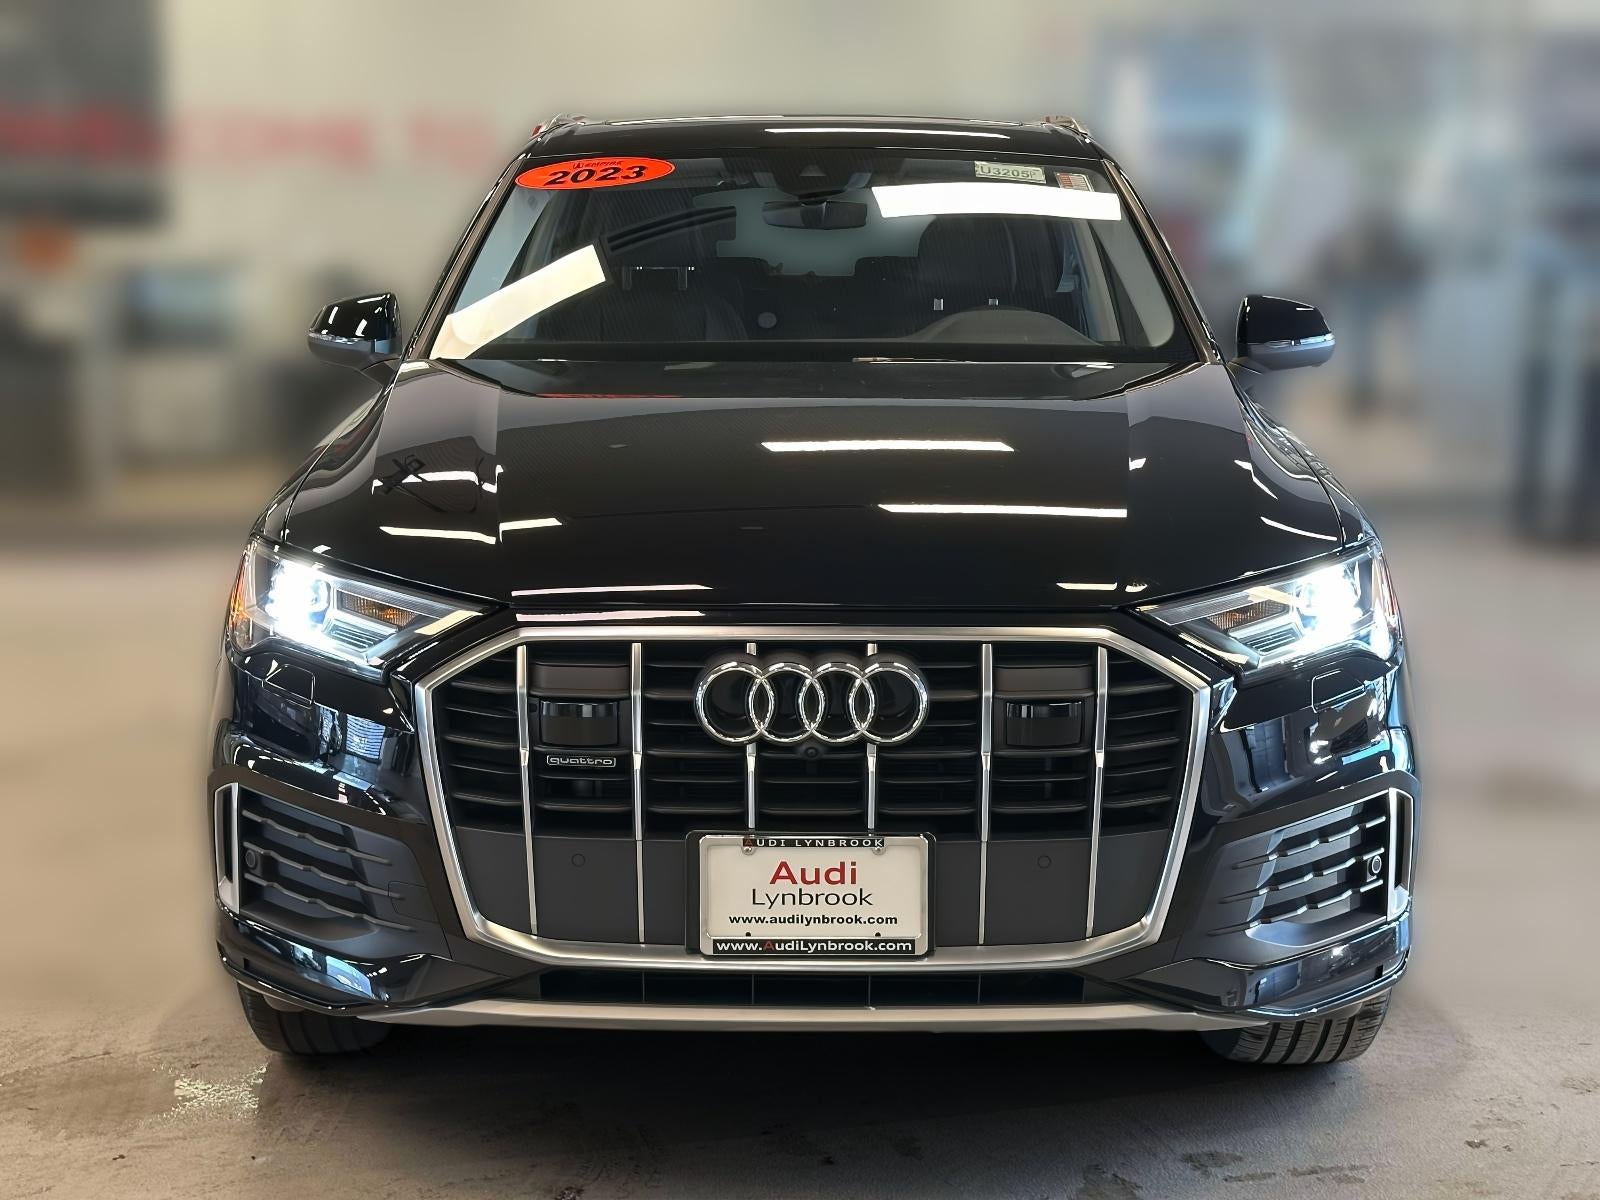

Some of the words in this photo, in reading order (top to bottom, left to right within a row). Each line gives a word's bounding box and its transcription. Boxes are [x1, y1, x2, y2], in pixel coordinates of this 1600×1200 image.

[543, 165, 648, 187] 2023
[549, 756, 613, 766] quattro
[744, 839, 786, 847] AUDI
[795, 839, 883, 847] LYNBROOK
[769, 860, 857, 885] Audi
[752, 888, 873, 909] Lynbrook
[728, 914, 898, 926] www.audilynbrook.com
[716, 939, 912, 953] www.AudiLynbrook.com
